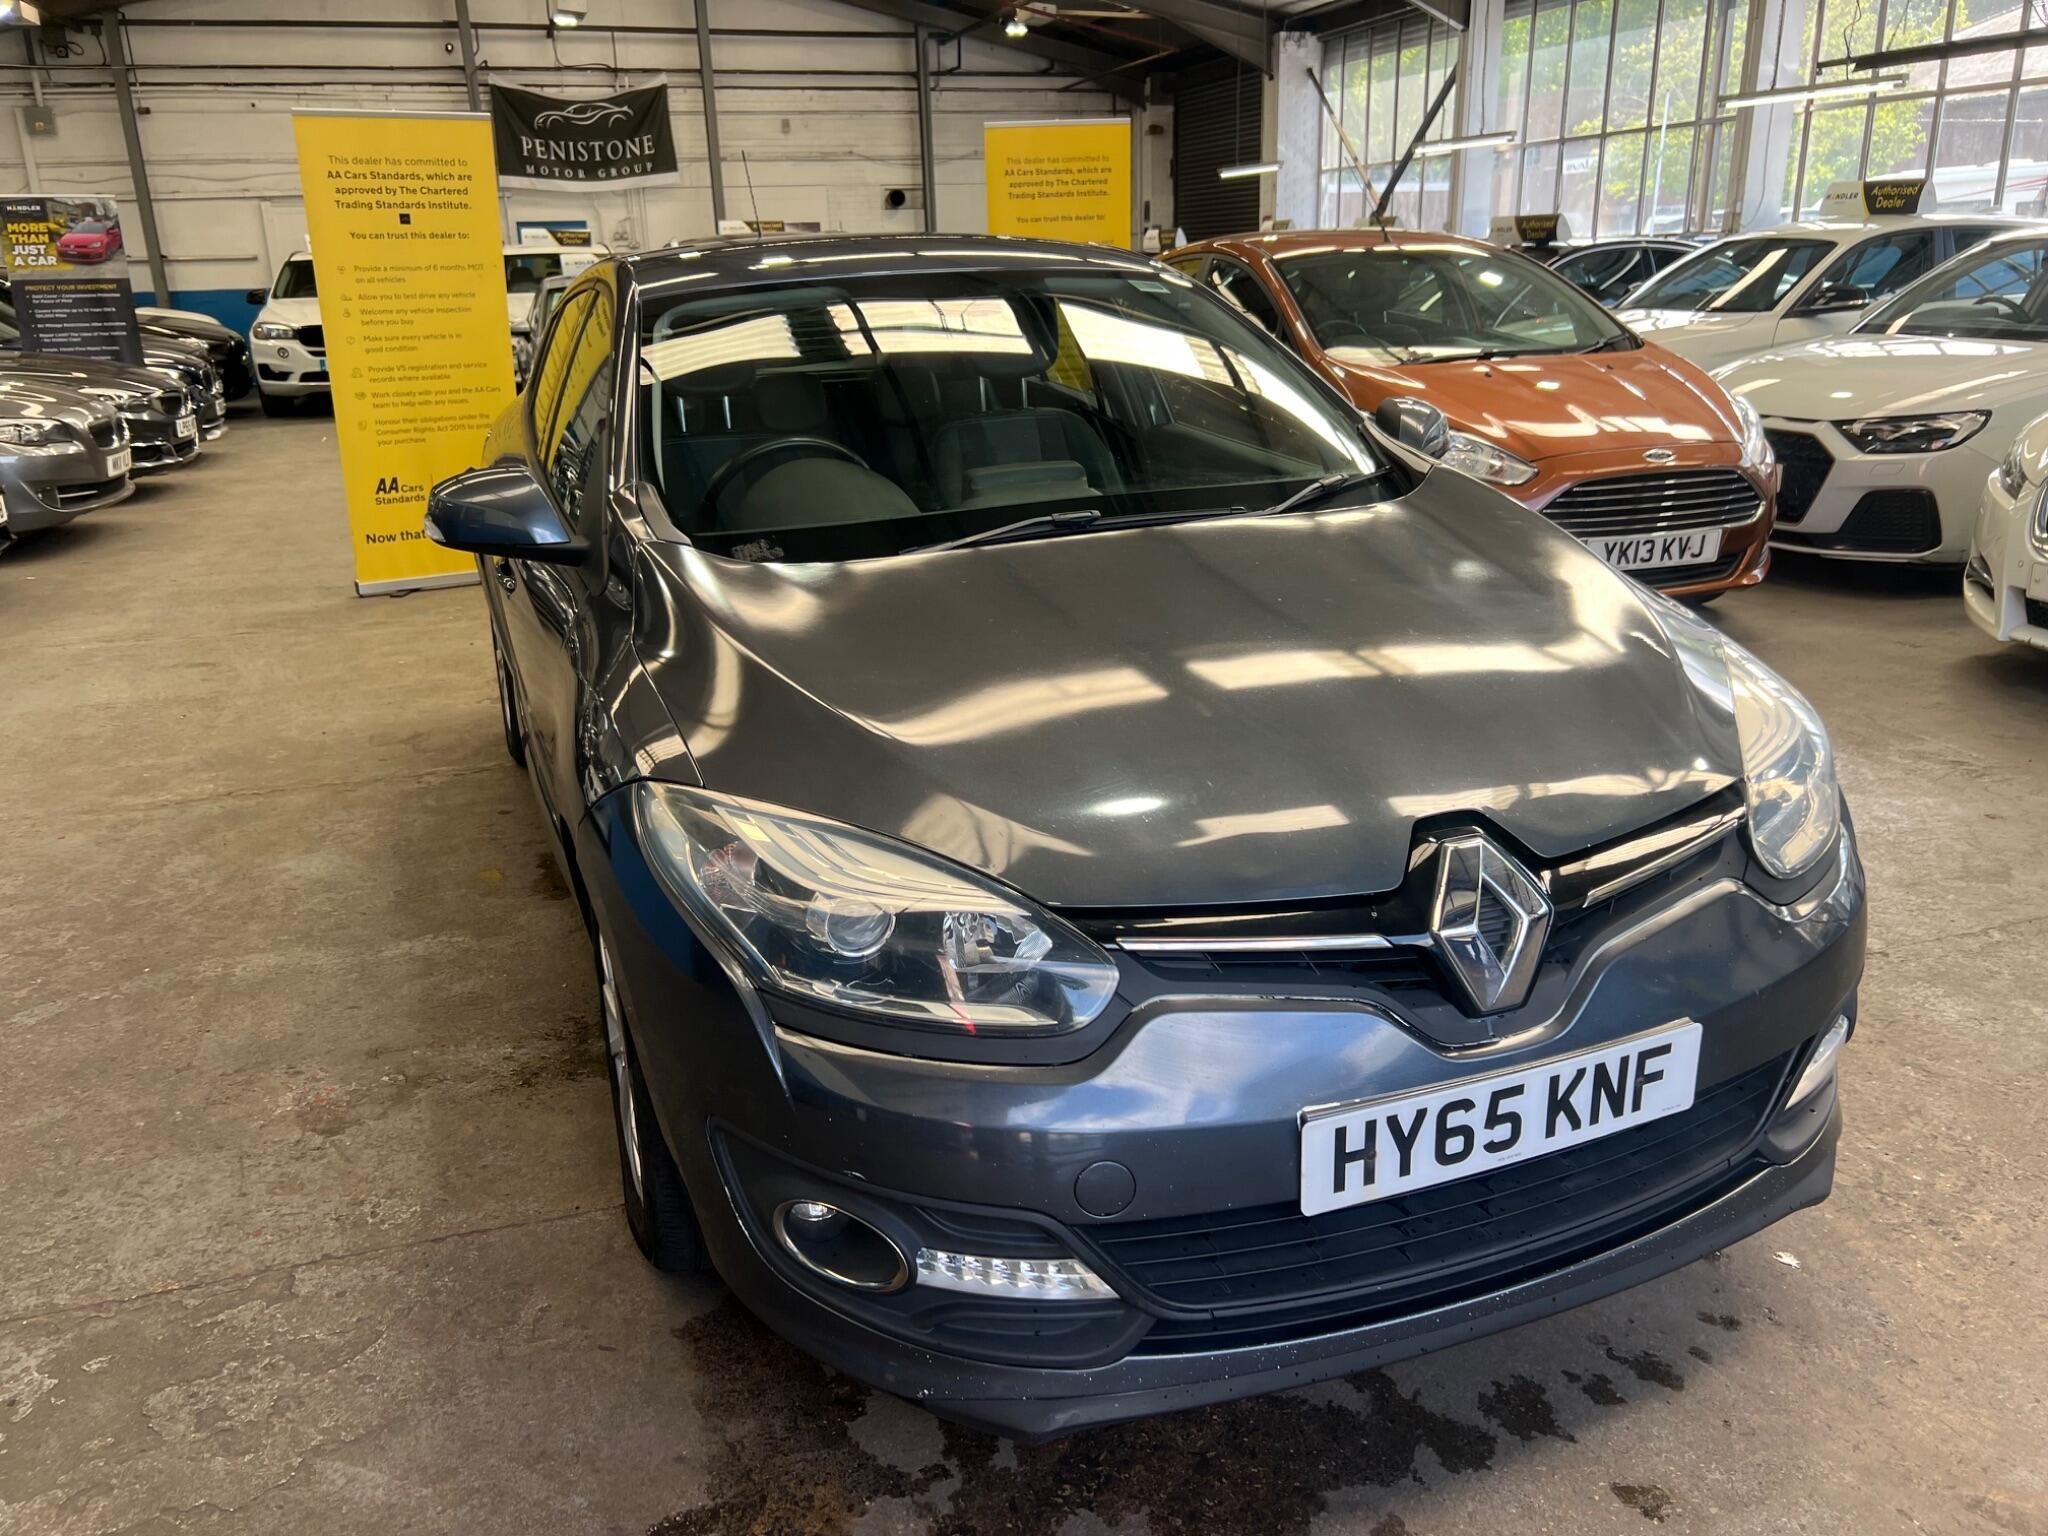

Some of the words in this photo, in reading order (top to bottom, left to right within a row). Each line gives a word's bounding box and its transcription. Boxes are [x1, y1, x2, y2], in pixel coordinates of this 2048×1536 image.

[520, 135, 655, 162] PENISTONE
[328, 155, 349, 165] This
[352, 156, 382, 165] dealer
[385, 156, 402, 166] has
[405, 157, 455, 166] committed
[458, 158, 468, 166] to
[525, 164, 586, 178] MOTOR
[598, 162, 653, 177] GROUP
[328, 171, 342, 179] AA
[344, 171, 367, 179] Cars
[370, 171, 424, 181] Standards,
[426, 172, 454, 180] which
[1009, 180, 1043, 189] approved
[1046, 180, 1054, 188] by
[1071, 178, 1108, 186] Chartered
[336, 186, 382, 195] approved
[386, 186, 396, 196] by
[399, 186, 417, 194] The
[420, 187, 468, 195] Chartered
[1008, 192, 1035, 200] Trading
[1038, 191, 1074, 199] Standards
[1871, 184, 1920, 196] Authorised
[335, 200, 372, 210] Trading
[376, 201, 426, 209] Standards
[429, 201, 472, 210] Institute.
[1876, 197, 1905, 208] Dealer
[7, 223, 48, 232] MORE
[9, 234, 49, 243] THAN
[350, 232, 366, 240] You
[12, 245, 46, 254] JUST
[14, 256, 24, 265] A
[28, 256, 57, 265] CAR
[376, 477, 399, 494] AA
[401, 484, 424, 493] Cars
[376, 494, 425, 505] Standards
[366, 533, 396, 544] Now
[1604, 539, 1654, 565] YK13
[1659, 534, 1706, 561] KVJ
[1333, 1083, 1525, 1193] HY65
[1544, 1042, 1672, 1139] KNF
